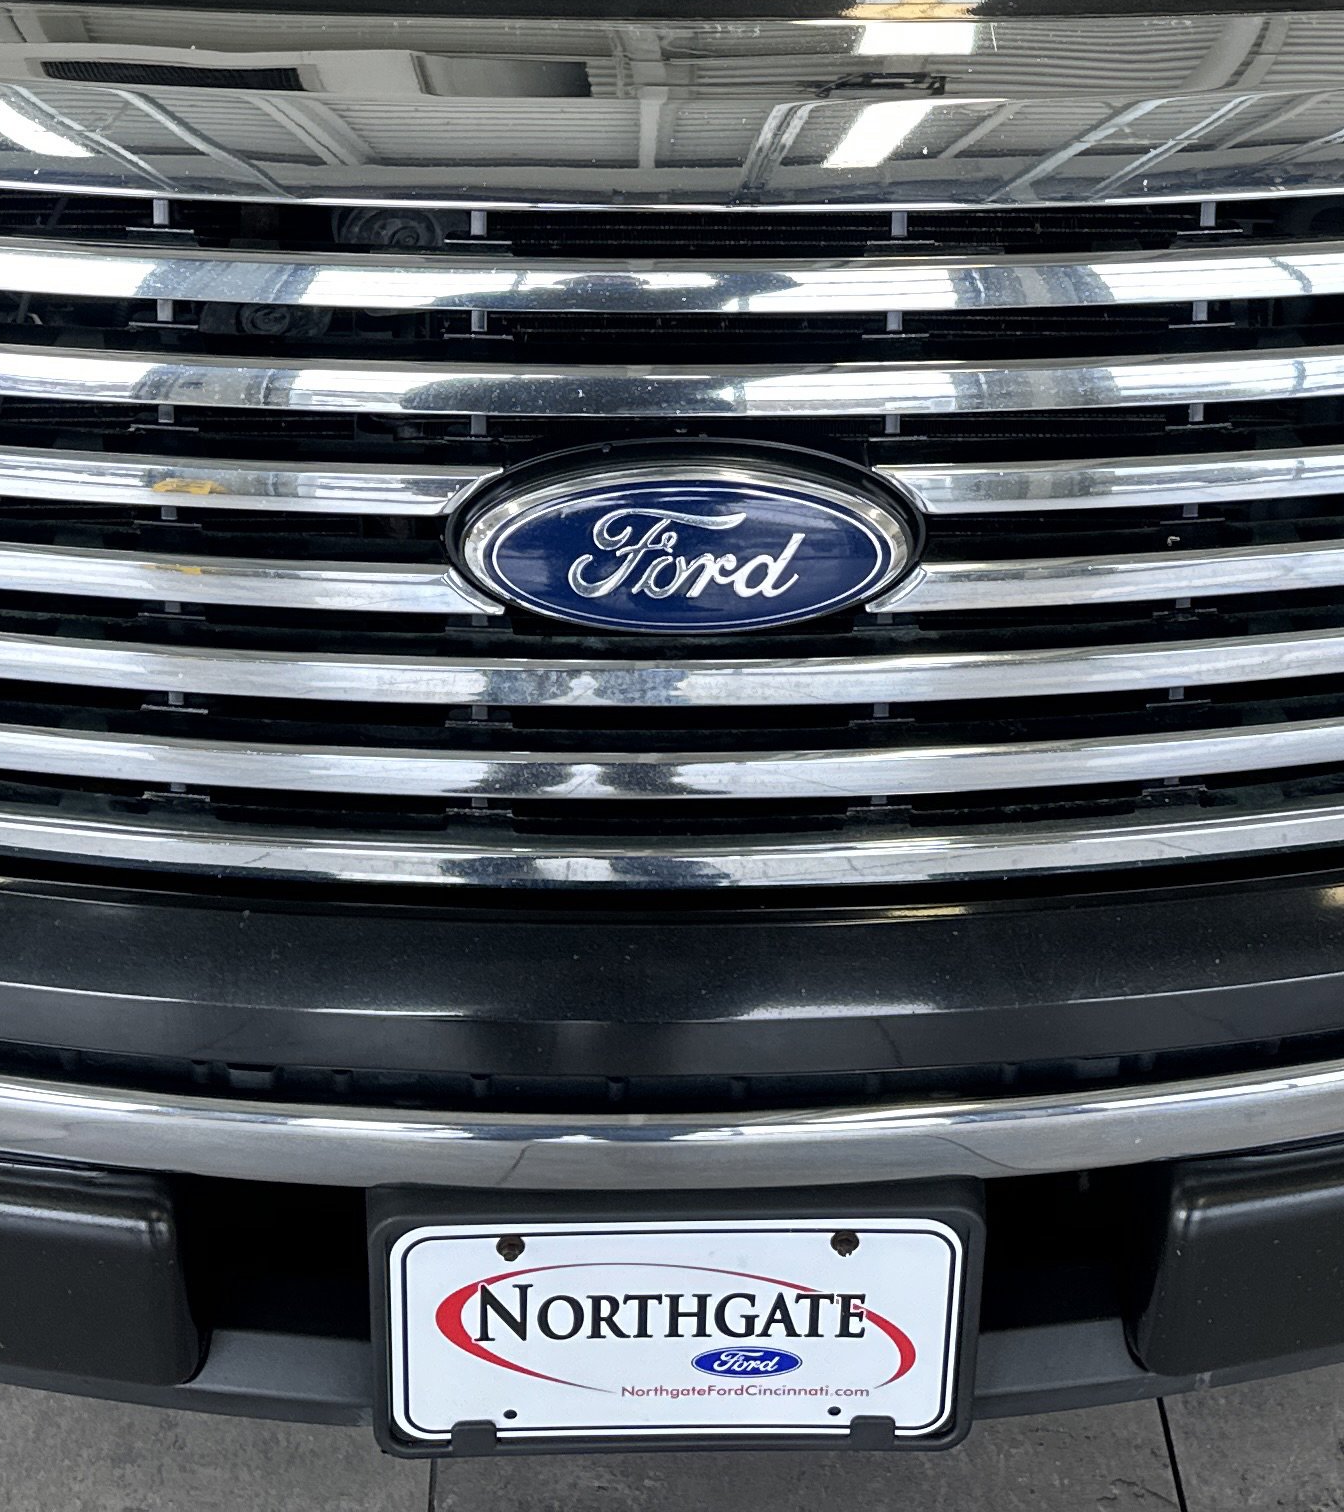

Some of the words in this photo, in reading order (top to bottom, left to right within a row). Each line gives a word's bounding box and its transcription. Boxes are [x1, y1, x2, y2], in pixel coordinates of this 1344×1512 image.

[567, 507, 806, 600] Ford
[473, 1283, 867, 1342] NORTHGATE
[713, 1350, 781, 1373] Ford
[620, 1384, 870, 1399] NorthgateFordCincinnati.com
